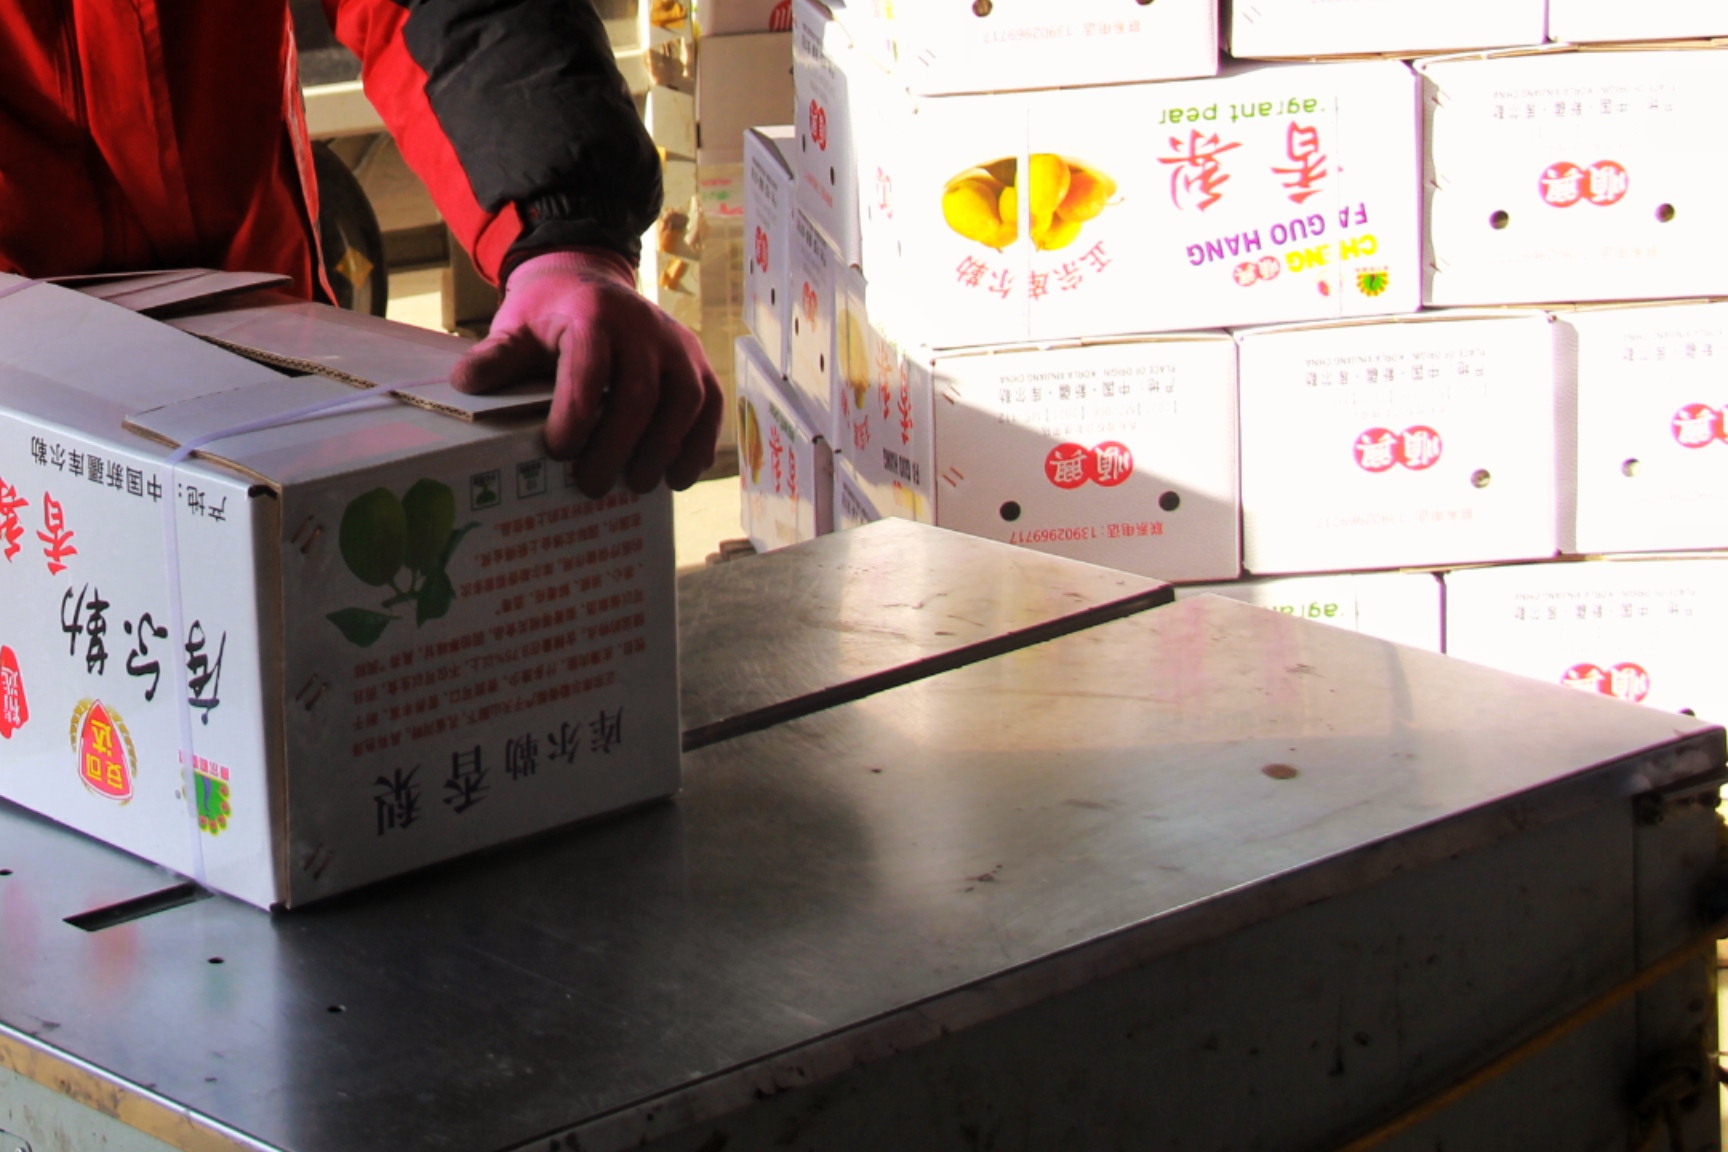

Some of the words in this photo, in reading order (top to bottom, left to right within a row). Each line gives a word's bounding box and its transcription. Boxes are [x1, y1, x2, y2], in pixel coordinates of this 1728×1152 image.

[1156, 104, 1217, 126] pear
[1155, 120, 1342, 211] 香梨
[1539, 165, 1625, 201] 順興
[1185, 227, 1259, 265] HANG
[1269, 211, 1324, 244] GUO
[1285, 232, 1377, 271] CHNG
[1673, 406, 1728, 444] 興
[1048, 444, 1128, 481] 順興
[1356, 430, 1438, 465] 順興
[61, 582, 225, 724] 库尔勒
[0, 665, 20, 724] 精选
[84, 718, 123, 789] 安可达
[373, 705, 622, 835] 库尔勒香梨
